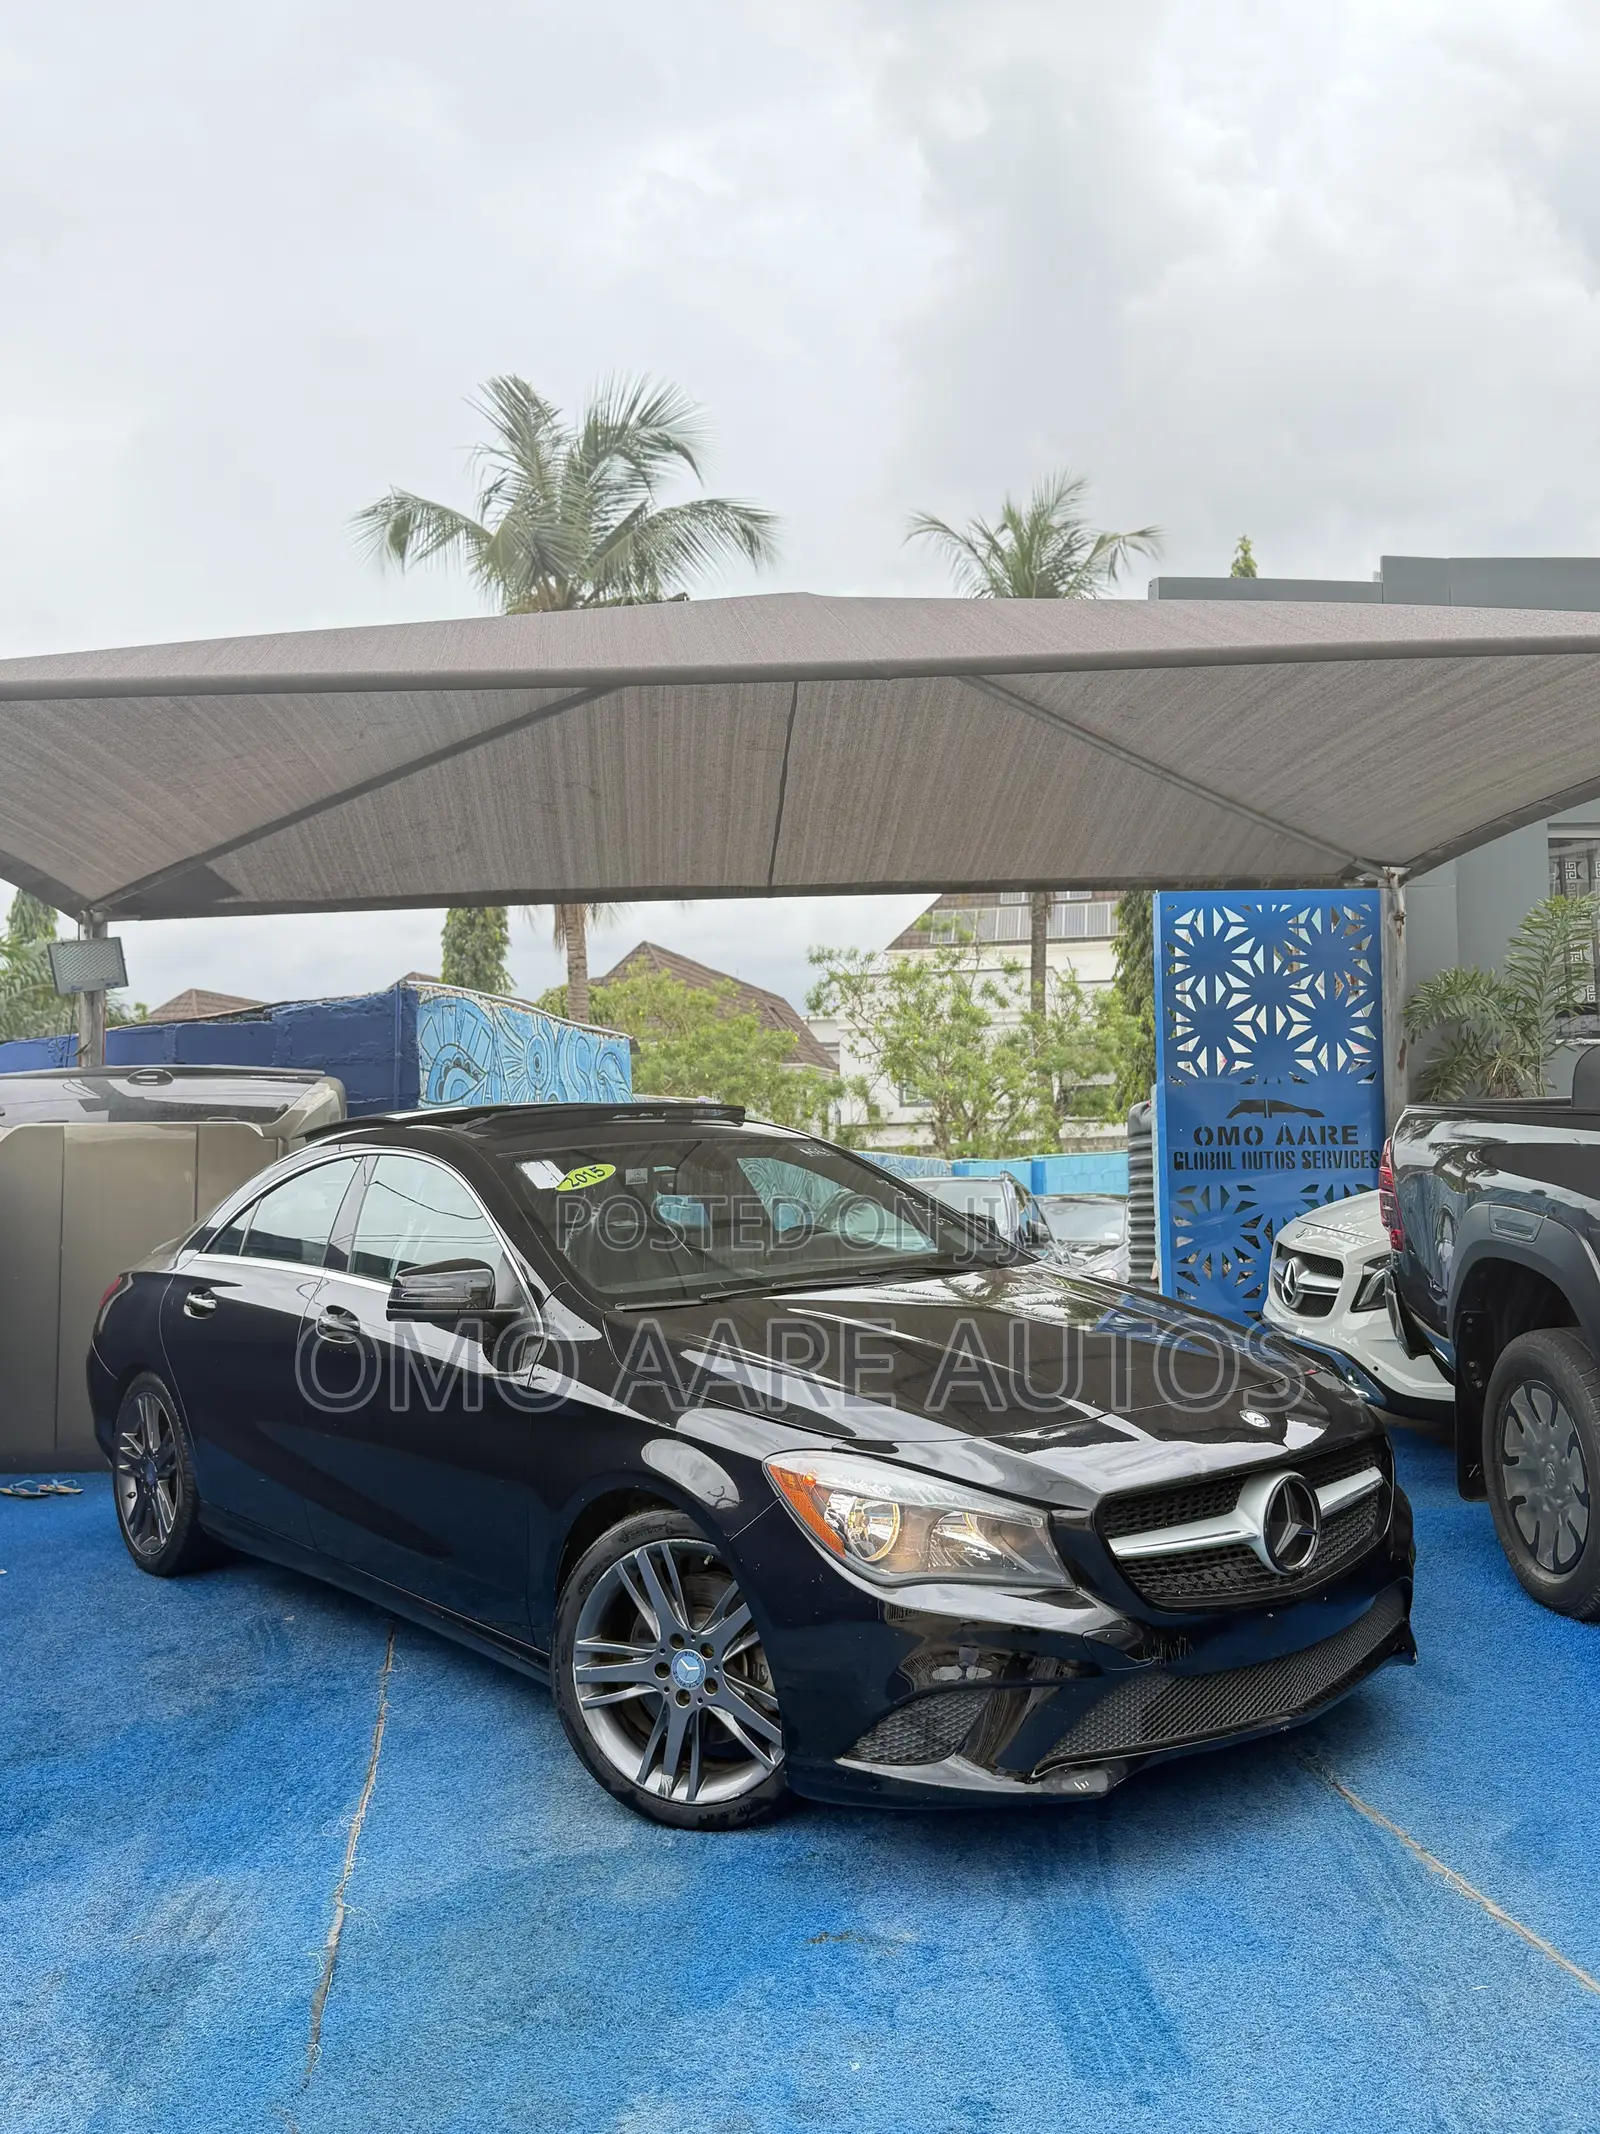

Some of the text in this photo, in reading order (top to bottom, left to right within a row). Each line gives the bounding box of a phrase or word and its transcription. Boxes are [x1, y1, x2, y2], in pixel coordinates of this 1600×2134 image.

[1193, 1125, 1359, 1147] OMO AARE
[1302, 1149, 1379, 1170] SERVICES
[562, 1166, 606, 1188] 2015
